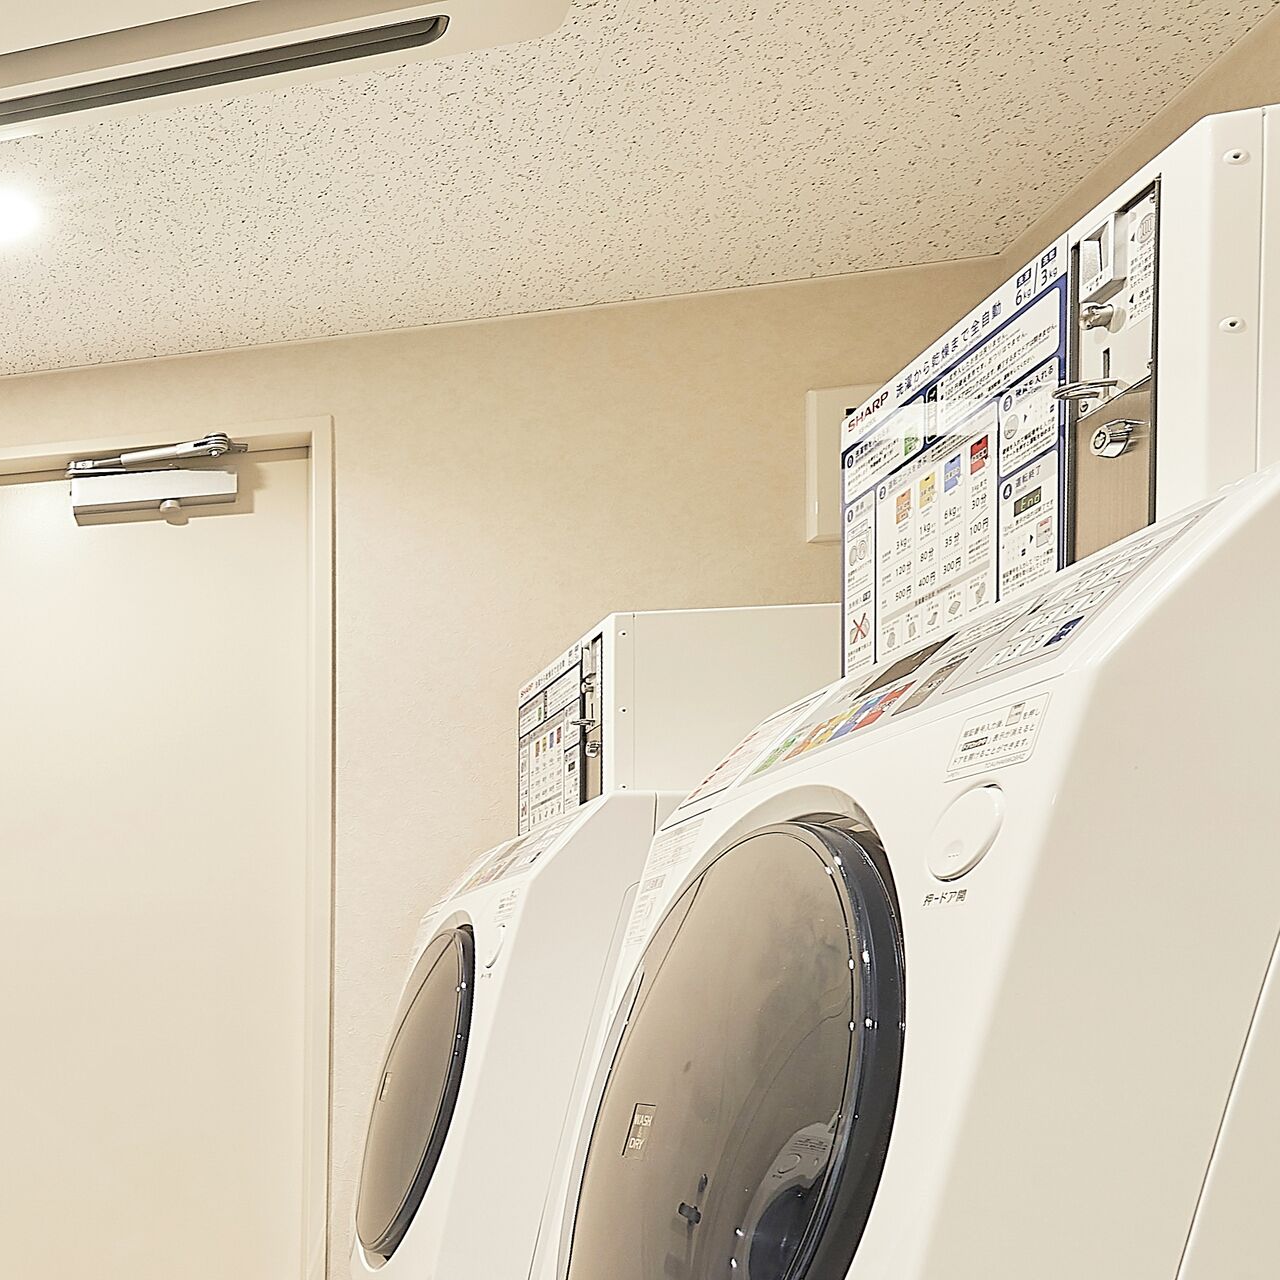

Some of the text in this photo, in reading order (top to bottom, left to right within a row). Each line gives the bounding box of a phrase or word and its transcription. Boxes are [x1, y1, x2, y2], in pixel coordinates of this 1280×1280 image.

[894, 299, 1002, 399] 洗濯から乾燥まで全自動
[847, 390, 889, 433] SHARP
[633, 1115, 653, 1127] WASH
[629, 1137, 645, 1150] DRY
